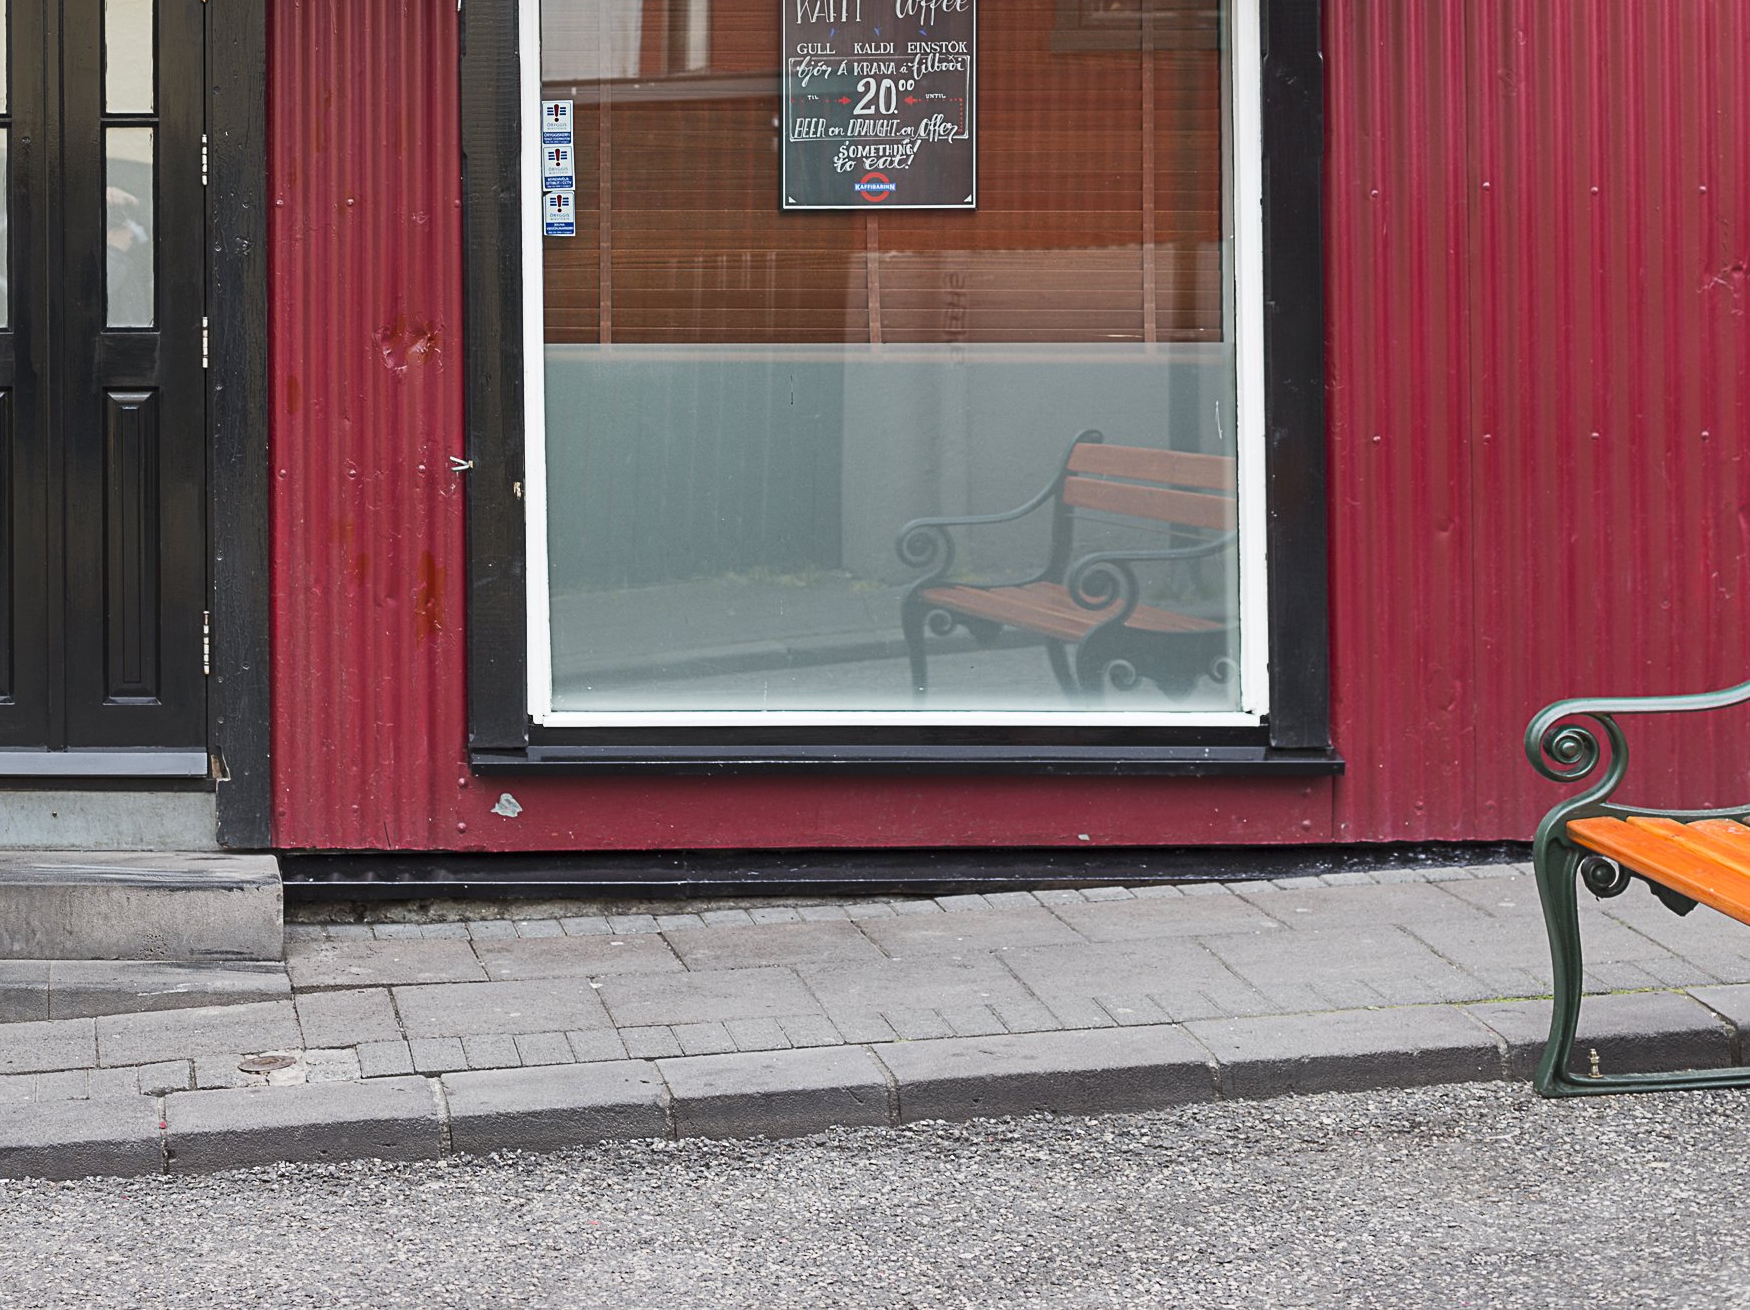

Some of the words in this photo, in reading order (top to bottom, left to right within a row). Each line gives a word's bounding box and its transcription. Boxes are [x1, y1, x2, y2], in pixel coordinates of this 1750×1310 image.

[797, 43, 836, 54] GULL
[854, 42, 894, 54] KALDI
[853, 62, 896, 76] KRANA
[794, 118, 827, 138] BEER
[833, 155, 856, 172] to
